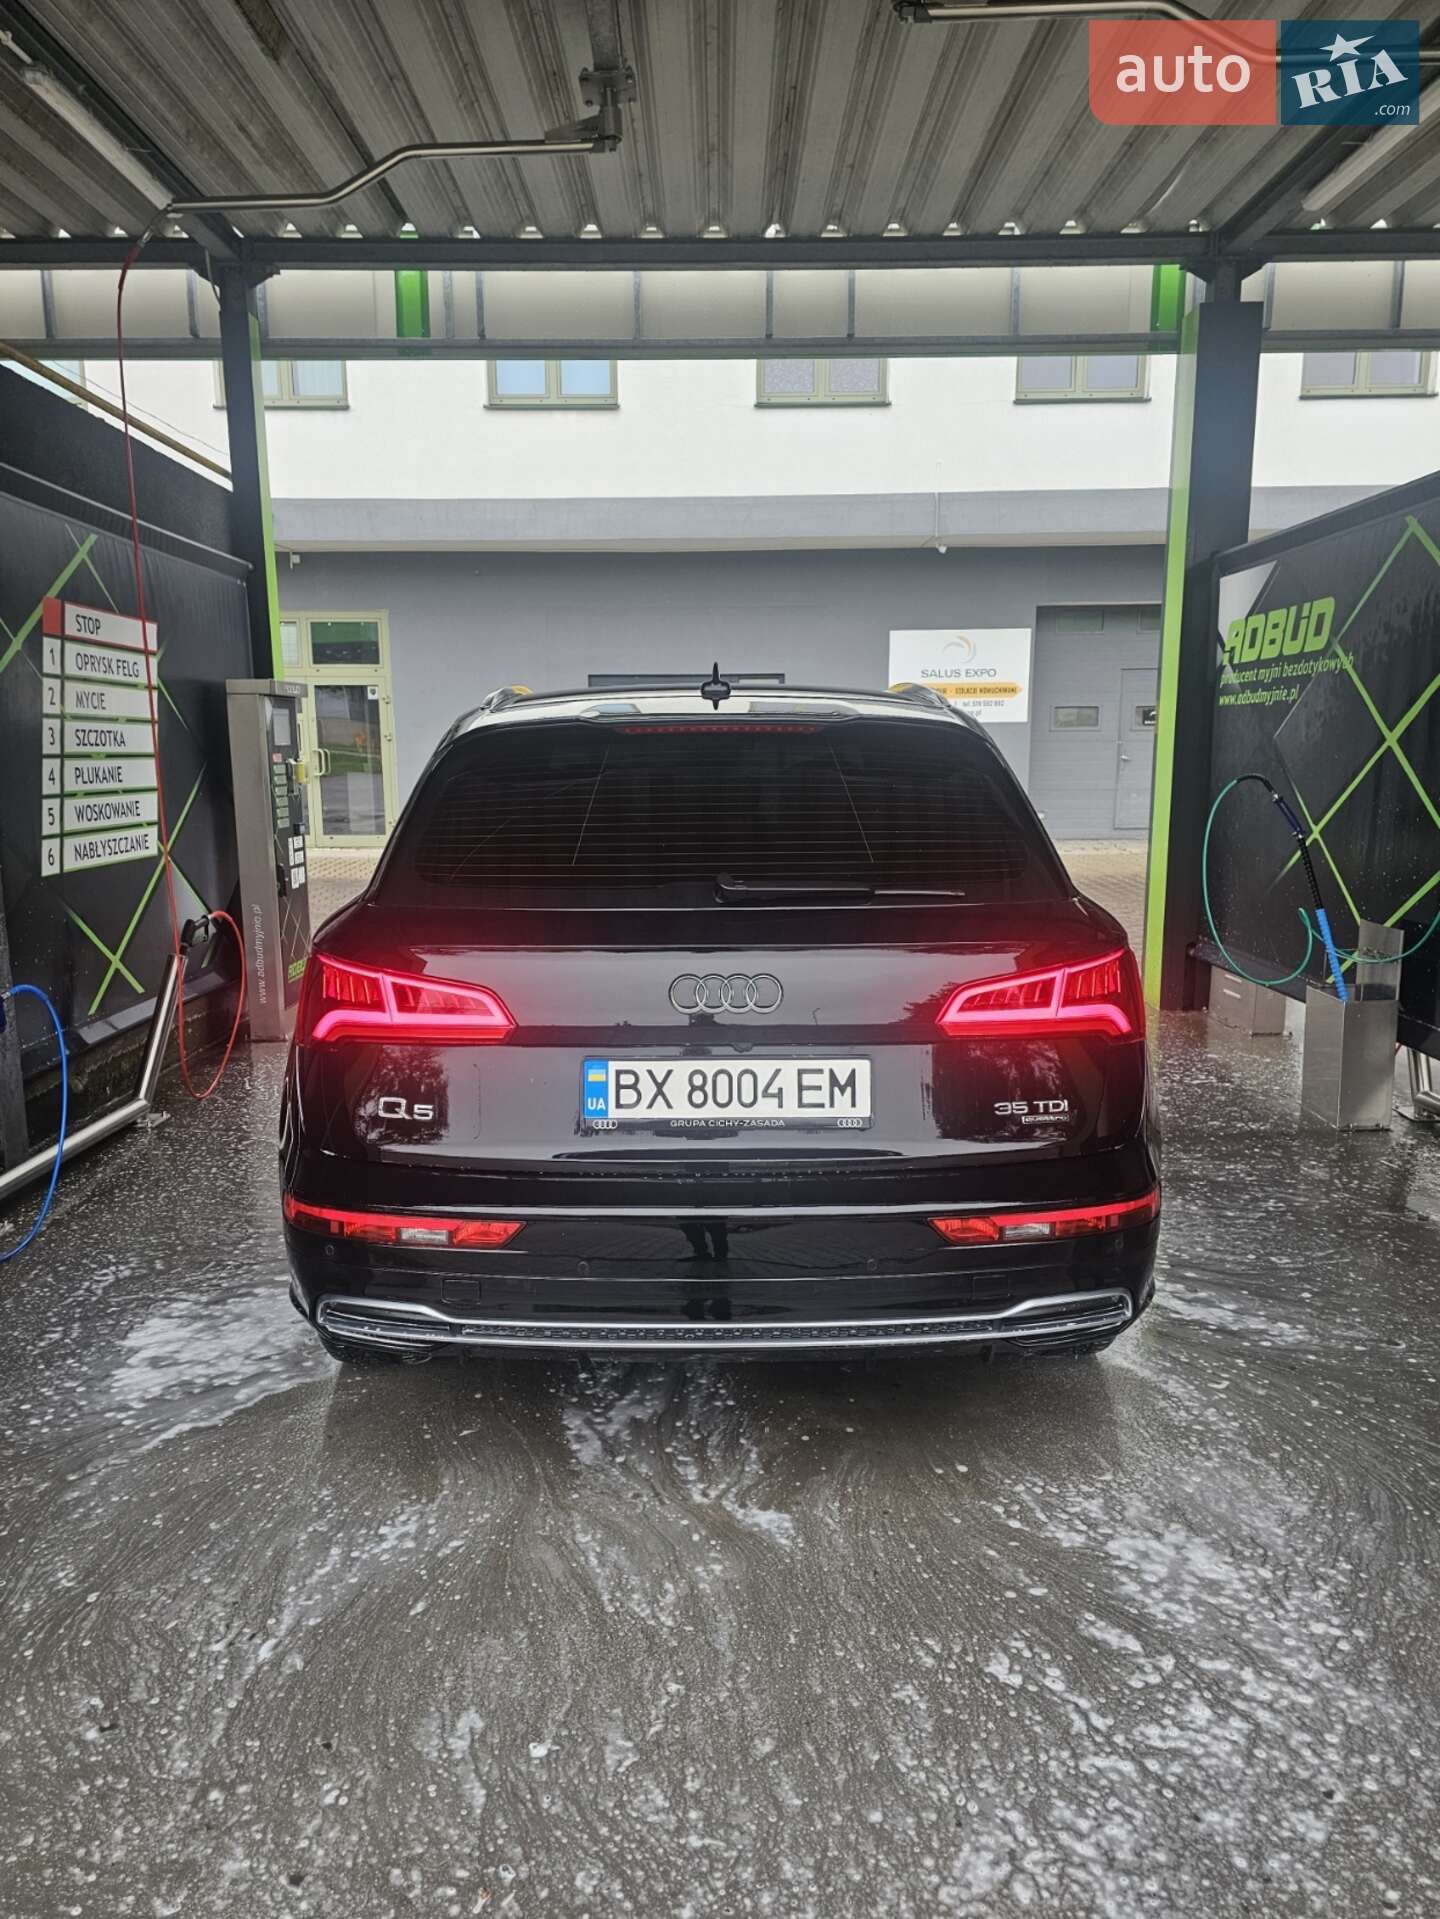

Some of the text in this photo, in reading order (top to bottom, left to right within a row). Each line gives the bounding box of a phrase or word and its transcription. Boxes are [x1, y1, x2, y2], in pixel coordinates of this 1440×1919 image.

[76, 614, 101, 635] STOP
[49, 649, 140, 679] 1 OPRYSK FELG
[921, 668, 997, 678] SALUS EXPO
[1258, 664, 1282, 683] myjni
[49, 687, 106, 710] 2 MYCIE
[49, 728, 125, 747] 3 SZCZOTKA
[48, 766, 123, 786] 4 PŁUKANIE
[48, 801, 140, 826] 5 WOSKOWANIE
[48, 834, 149, 866] 6 NABŁYSZCZANIE
[614, 1068, 857, 1109] BX 8004 EM
[378, 1097, 434, 1120] Q5
[587, 1097, 606, 1110] UA
[993, 1099, 1069, 1115] 35 TDI
[670, 1119, 785, 1128] GRUPA CICHY-ZASADA
